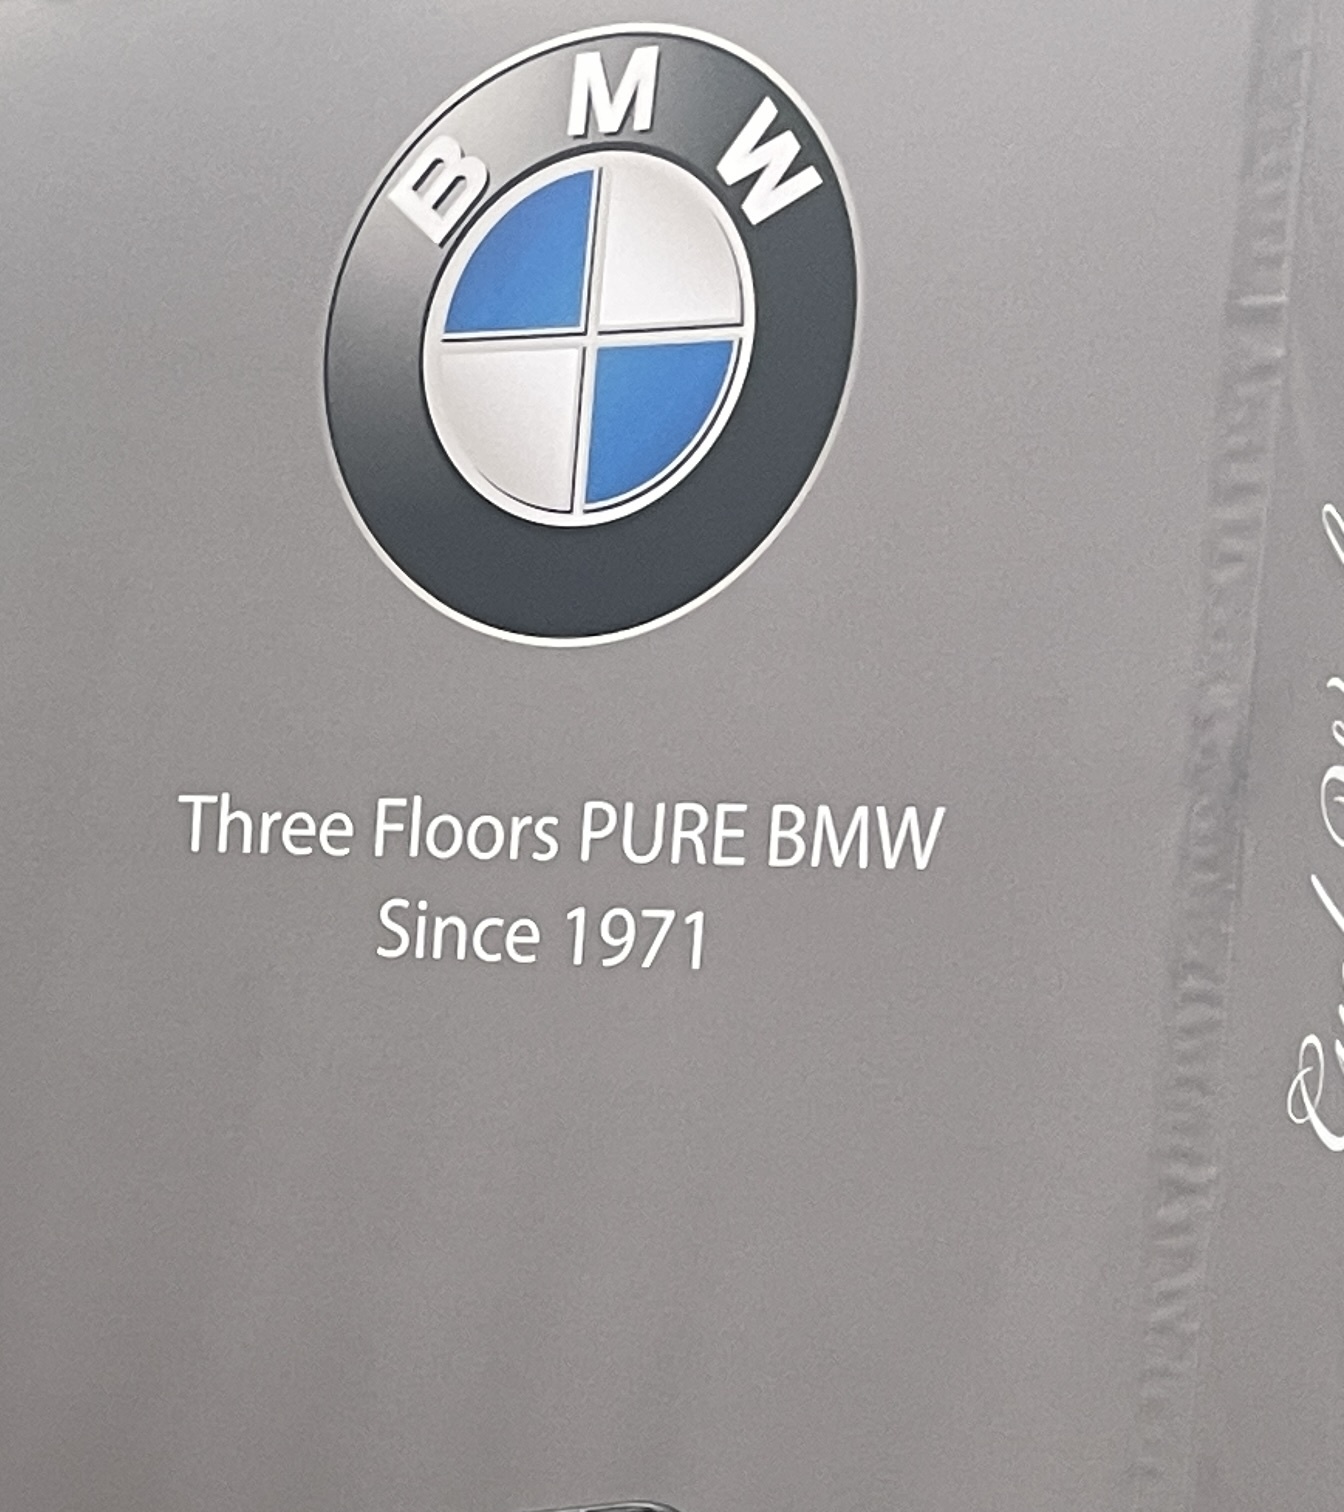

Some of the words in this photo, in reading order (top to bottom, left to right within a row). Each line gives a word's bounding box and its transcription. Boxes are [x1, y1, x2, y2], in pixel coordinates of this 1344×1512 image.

[387, 45, 823, 246] BMW
[177, 791, 354, 857] Three
[374, 794, 559, 862] Floors
[580, 799, 748, 867] PURE
[768, 803, 947, 871] BMW
[376, 898, 541, 964] Since
[566, 906, 705, 970] 1971
